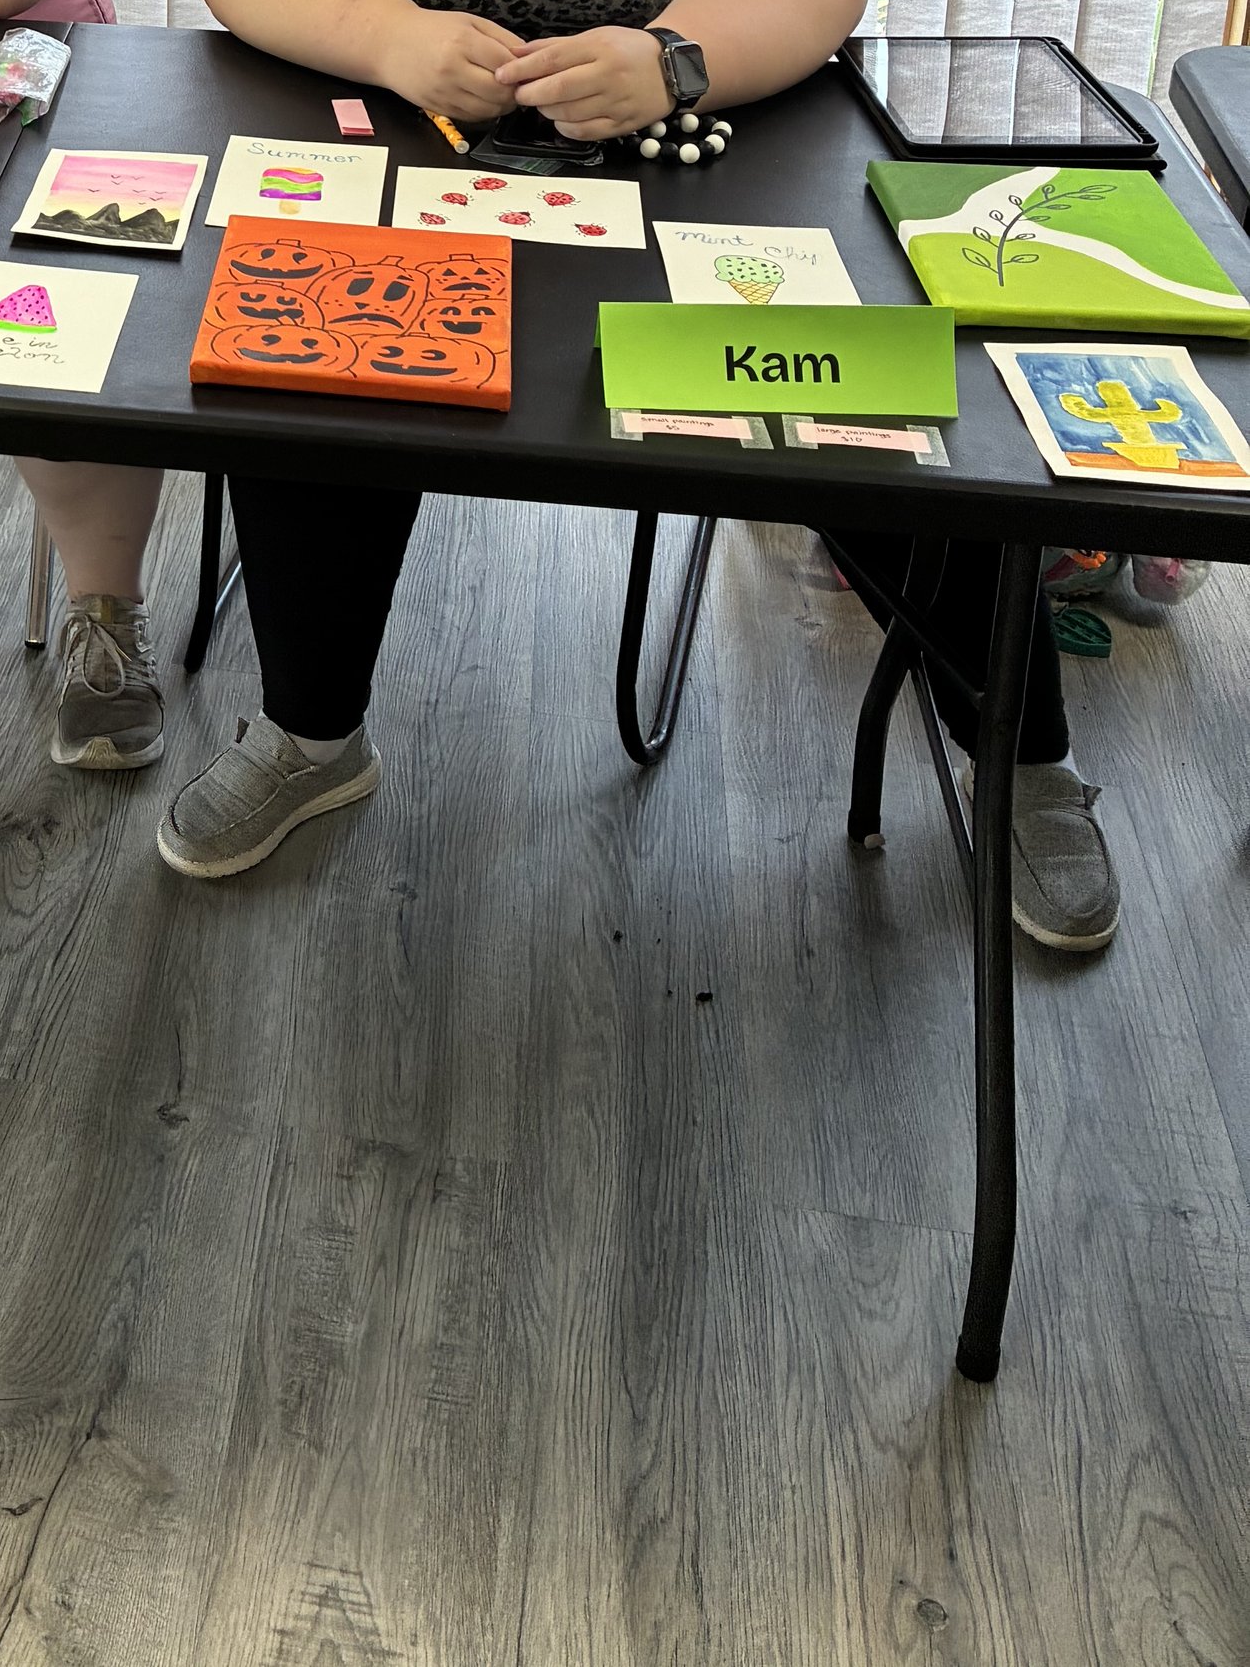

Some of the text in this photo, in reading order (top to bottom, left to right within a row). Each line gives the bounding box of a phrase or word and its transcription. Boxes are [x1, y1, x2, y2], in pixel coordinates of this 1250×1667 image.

[247, 142, 363, 163] Summer
[29, 337, 58, 349] in
[725, 345, 841, 383] Kam
[845, 430, 891, 439] paintings
